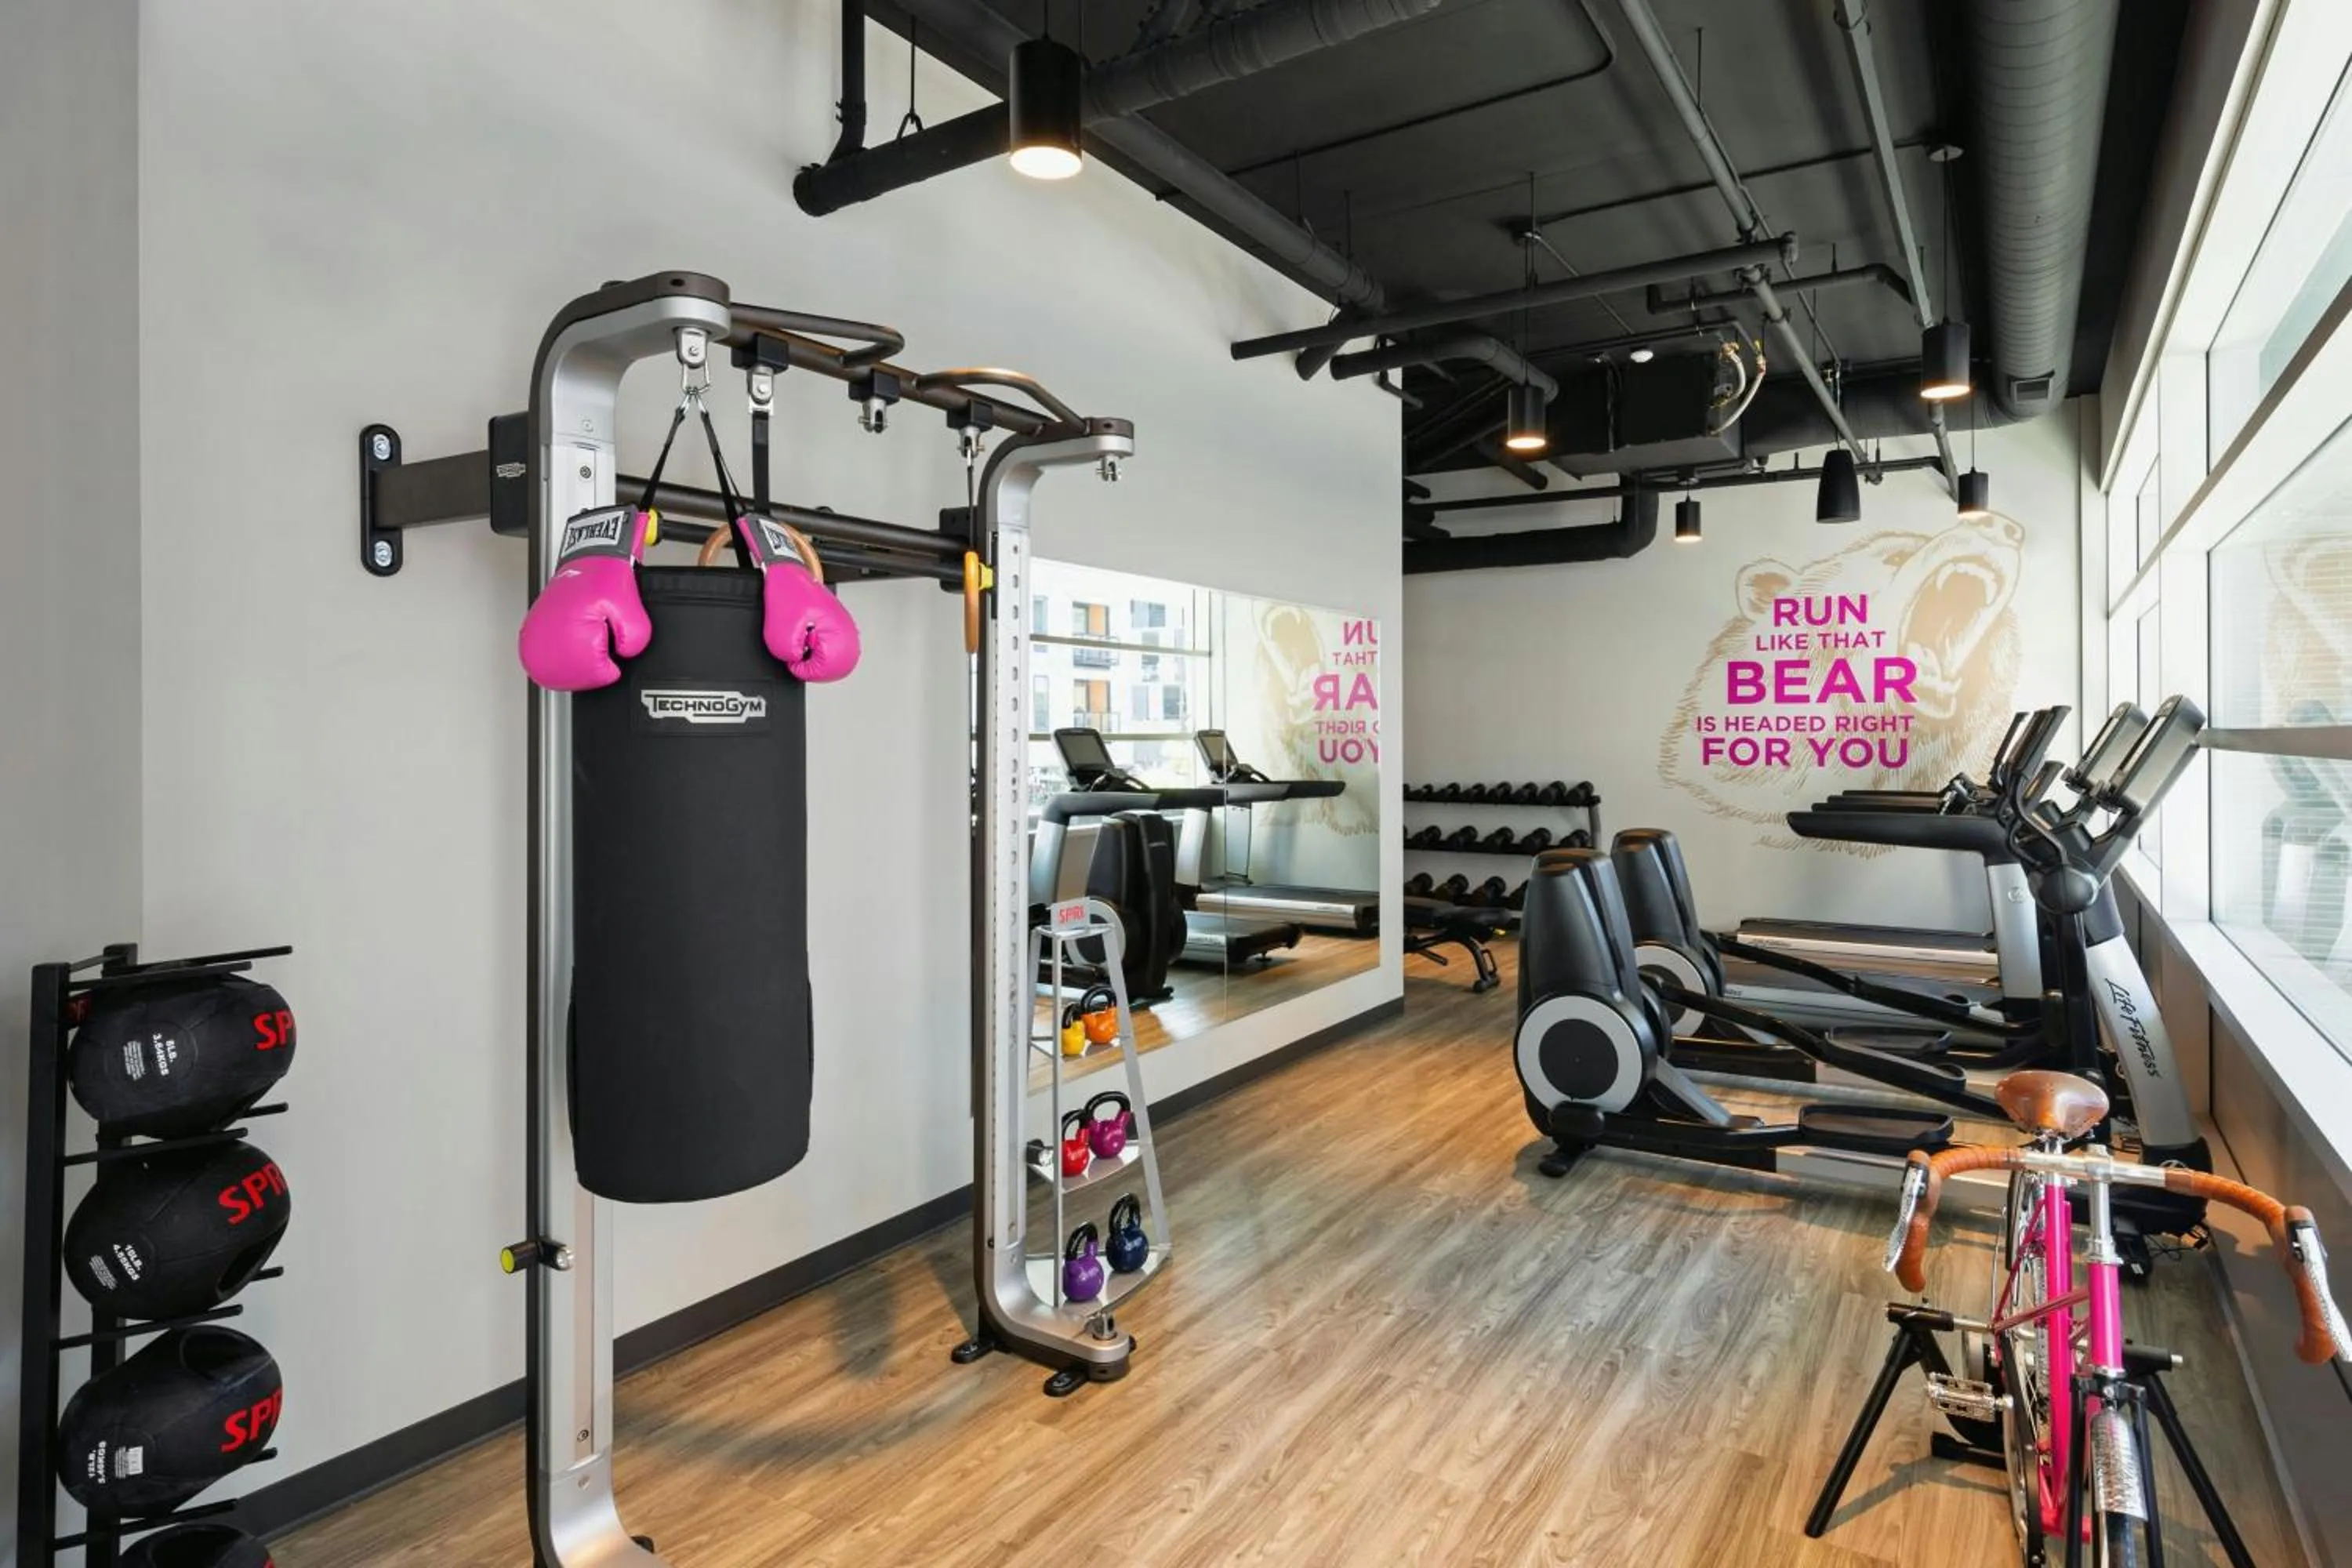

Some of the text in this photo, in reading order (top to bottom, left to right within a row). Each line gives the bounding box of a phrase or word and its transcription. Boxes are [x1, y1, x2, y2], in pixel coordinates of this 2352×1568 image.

[1773, 594, 1867, 626] RUN
[1756, 630, 1886, 652] LIKE THAT
[1727, 657, 1918, 704] BEAR
[1697, 715, 1915, 732] IS HEADED RIGHT
[1702, 738, 1908, 768] FOR YOU
[253, 1009, 296, 1051] SP
